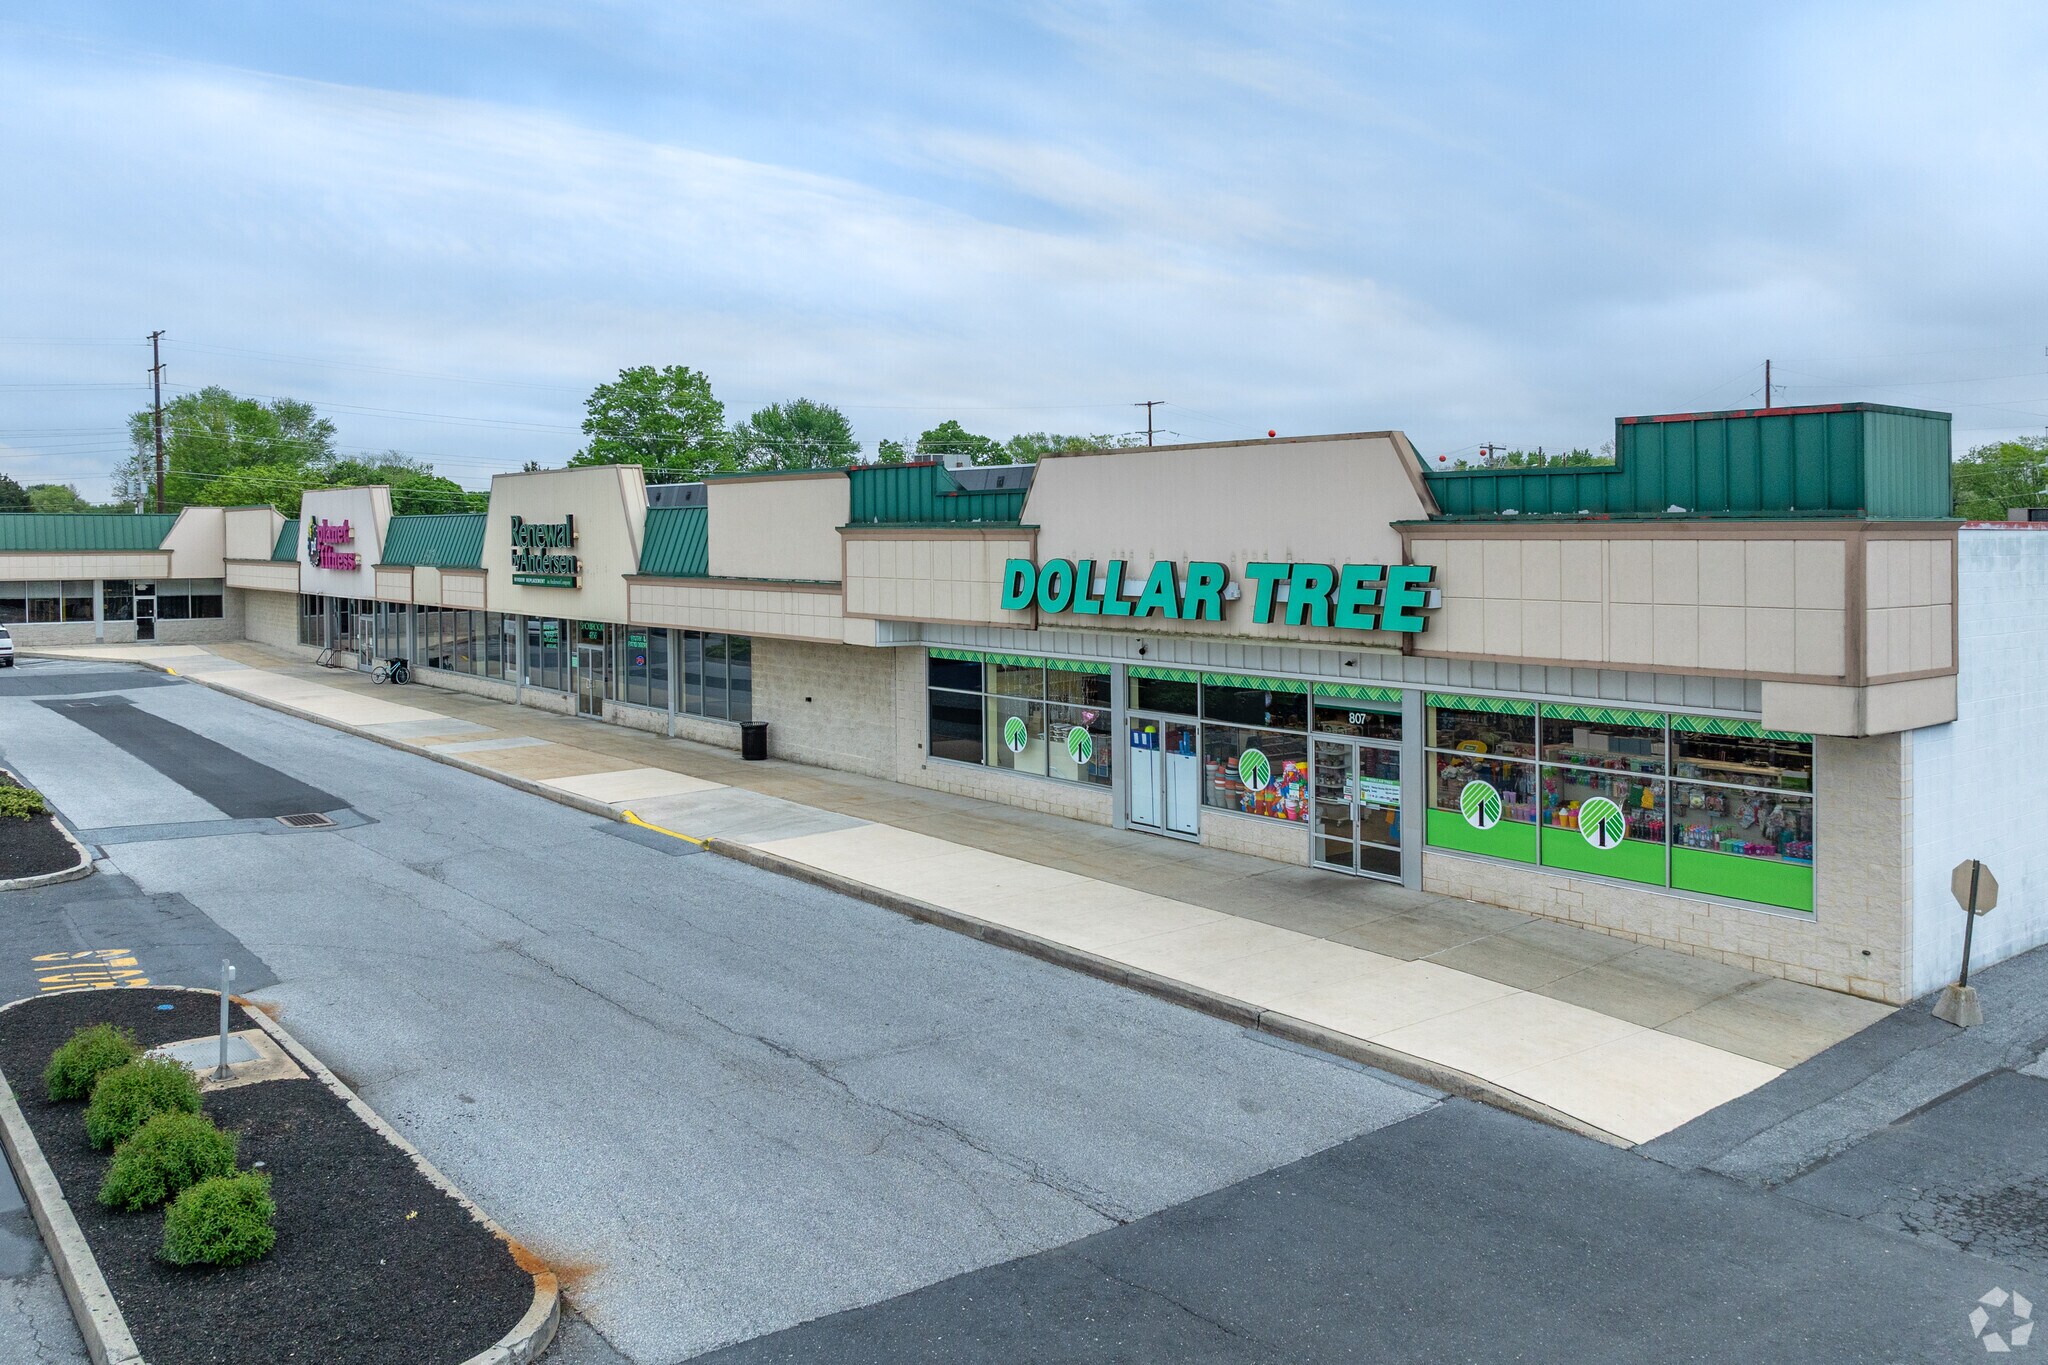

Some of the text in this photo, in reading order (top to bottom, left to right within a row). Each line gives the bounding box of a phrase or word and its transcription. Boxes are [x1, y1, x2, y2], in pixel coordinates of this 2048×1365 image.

[317, 519, 351, 549] planet
[511, 514, 574, 548] Renewal
[320, 545, 356, 570] fitness
[512, 548, 577, 574] by Andersen
[1001, 558, 1437, 633] DOLLAR TREE
[1349, 712, 1366, 725] 807
